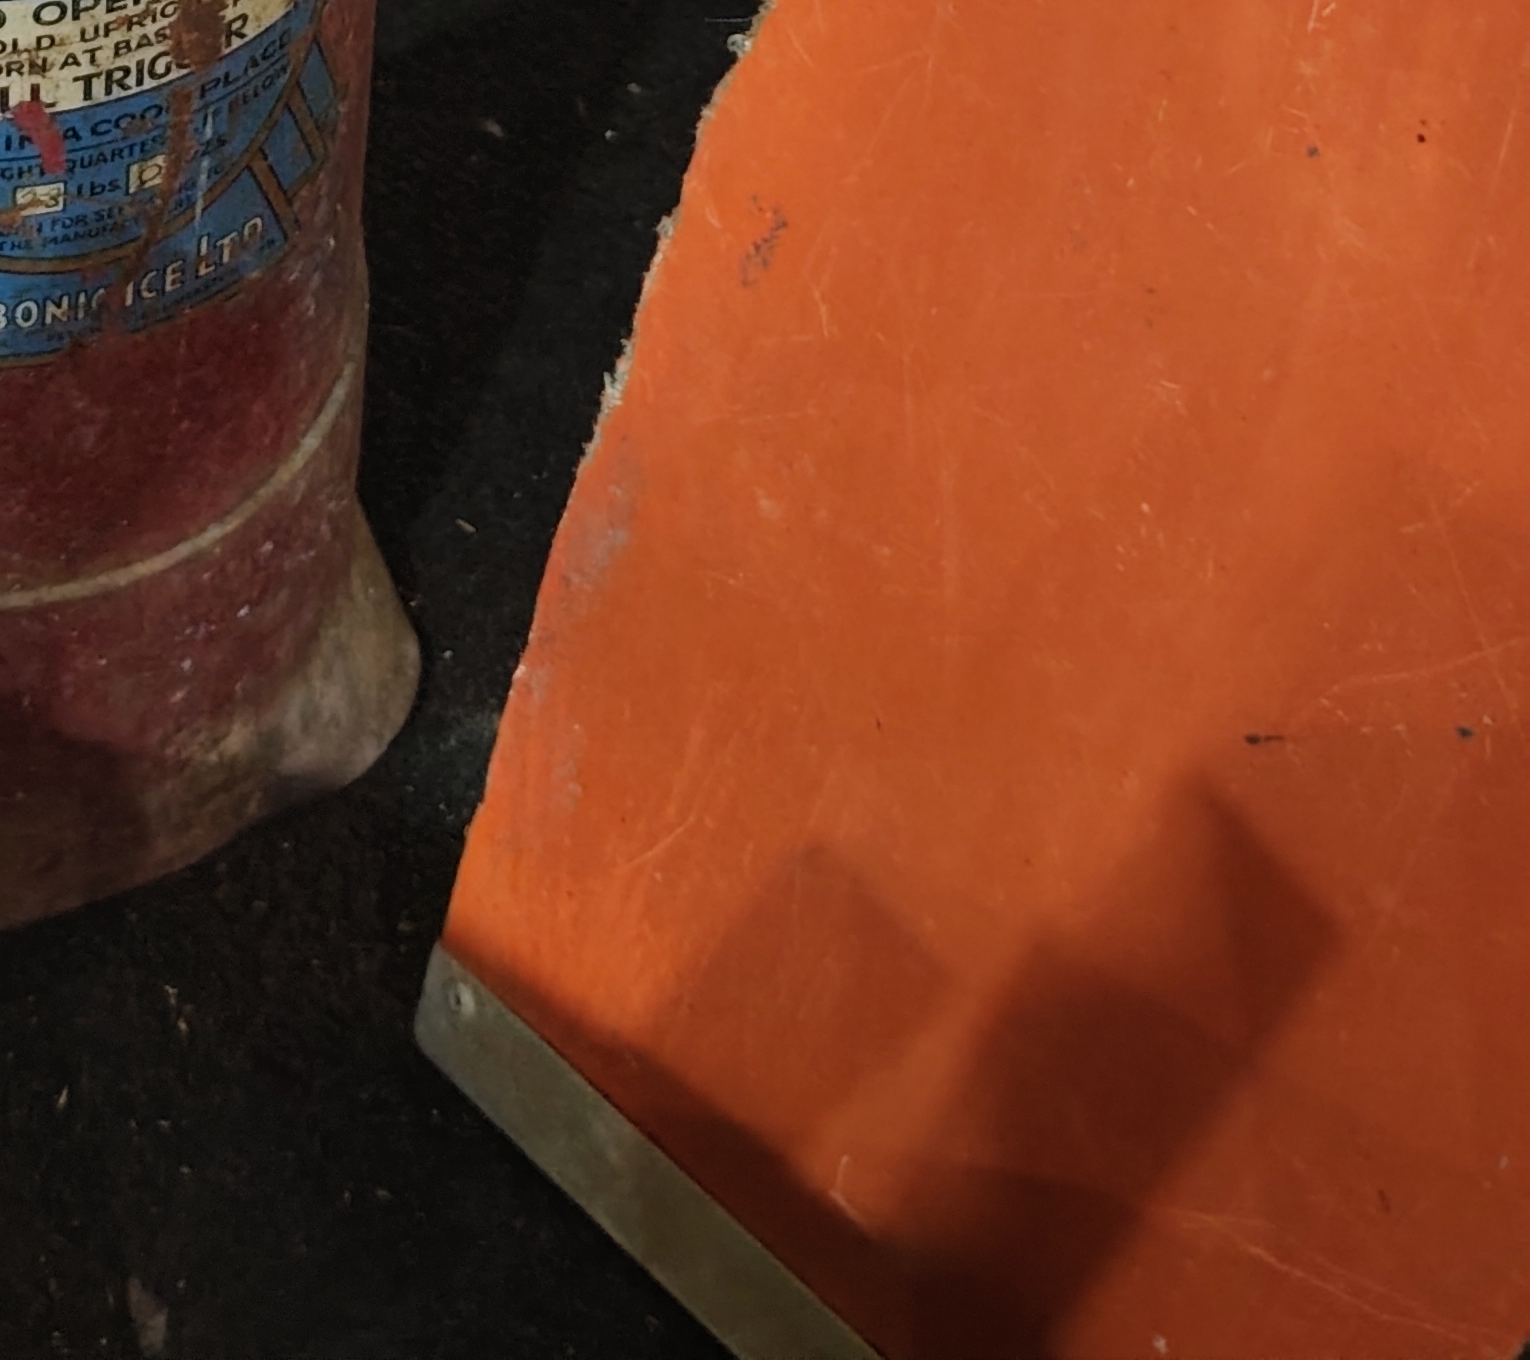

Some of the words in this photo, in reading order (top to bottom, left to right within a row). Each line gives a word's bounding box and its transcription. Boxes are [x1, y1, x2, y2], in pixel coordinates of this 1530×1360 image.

[58, 46, 99, 71] AT
[112, 25, 182, 58] BAS
[72, 12, 249, 102] TRIGR
[62, 125, 82, 142] A
[90, 101, 176, 138] COO
[123, 259, 184, 309] ICE
